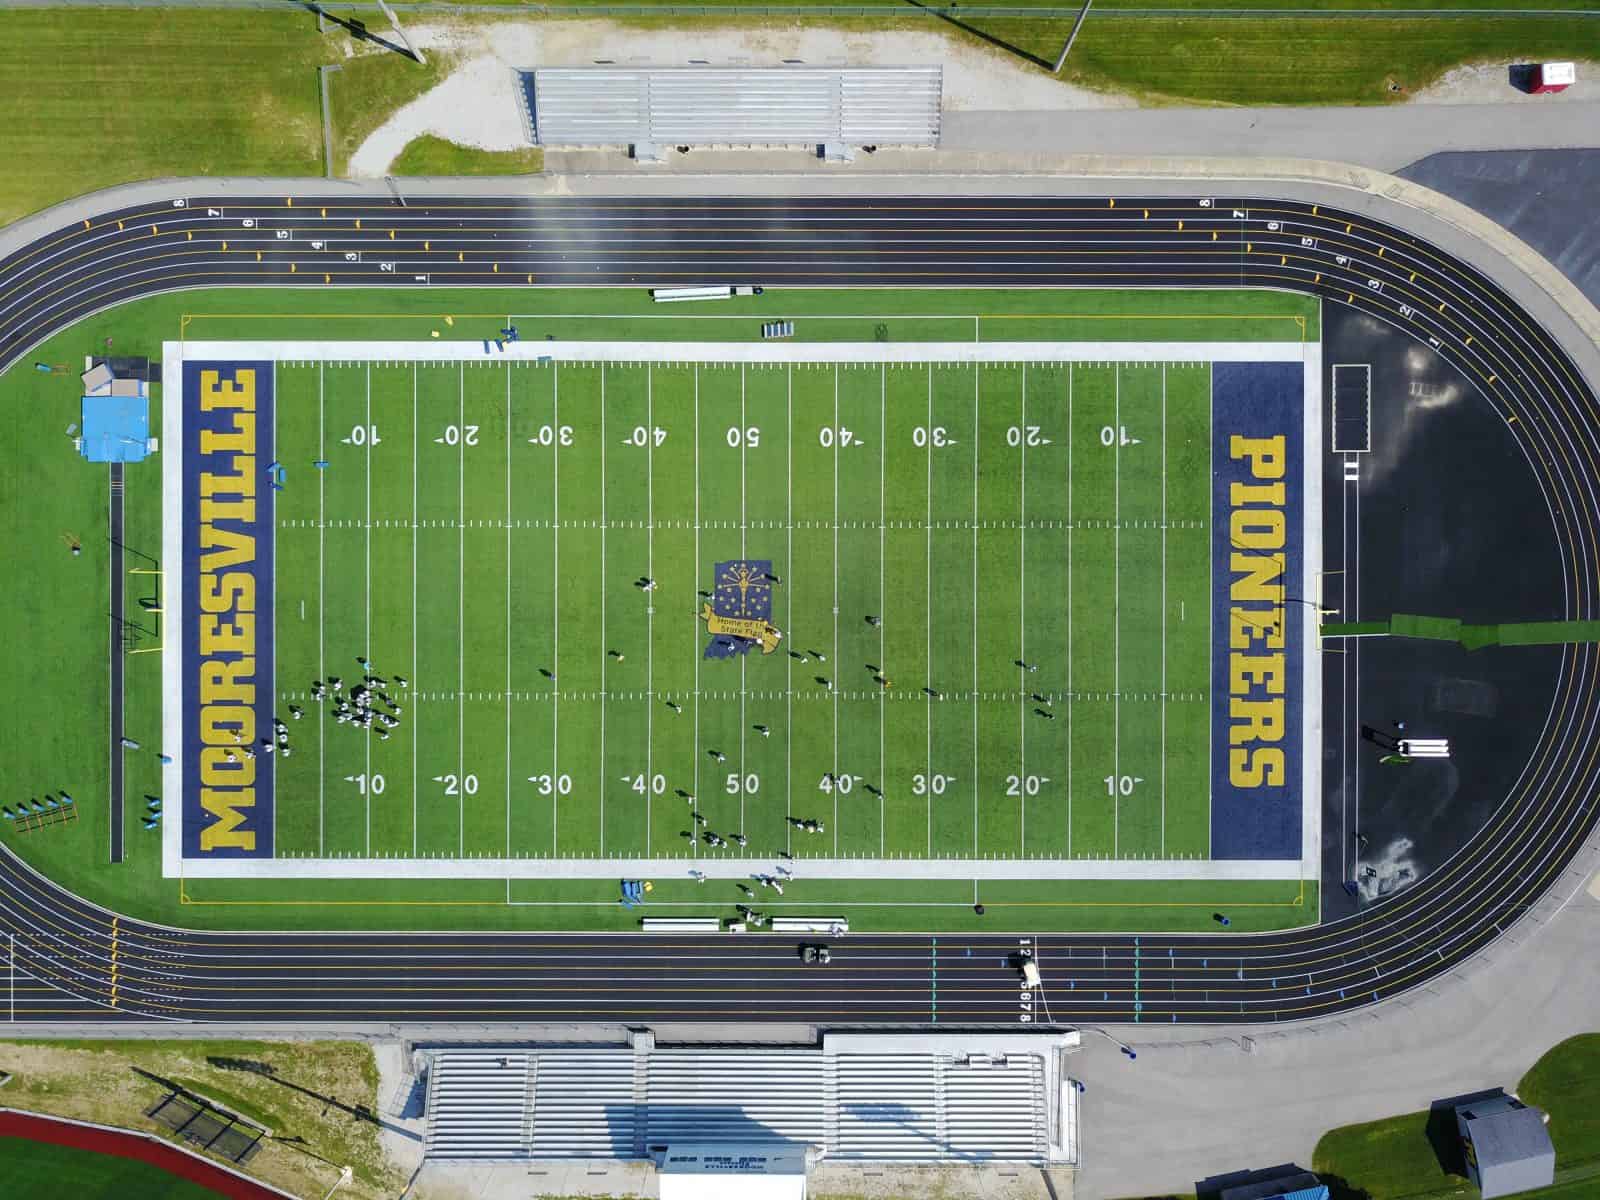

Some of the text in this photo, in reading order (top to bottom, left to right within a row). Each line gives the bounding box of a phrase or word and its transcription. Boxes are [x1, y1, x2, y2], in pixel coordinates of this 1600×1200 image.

[173, 199, 185, 207] 8
[208, 208, 220, 217] 7
[1199, 199, 1211, 207] 8
[1233, 209, 1245, 218] 7
[276, 230, 288, 239] 5
[1301, 237, 1313, 246] 5
[311, 242, 323, 250] 4
[345, 252, 357, 261] 3
[1335, 255, 1347, 264] 4
[380, 263, 392, 271] 2
[1367, 279, 1380, 289] 3
[1400, 304, 1411, 316] 2
[351, 425, 382, 446] 10
[445, 425, 479, 446] 20
[539, 425, 573, 446] 30
[633, 426, 667, 447] 40
[725, 427, 758, 447] 50
[819, 427, 853, 447] 40
[912, 427, 947, 447] 30
[1006, 426, 1041, 447] 20
[1100, 426, 1131, 447] 10
[200, 368, 256, 851] MOORESVILLE
[1229, 435, 1286, 788] PIONEERS
[355, 774, 385, 795] 10
[444, 774, 479, 795] 20
[538, 774, 572, 794] 30
[632, 774, 666, 794] 40
[725, 774, 758, 794] 50
[818, 774, 852, 794] 40
[912, 774, 946, 795] 30
[1005, 774, 1040, 795] 20
[1103, 774, 1133, 795] 10
